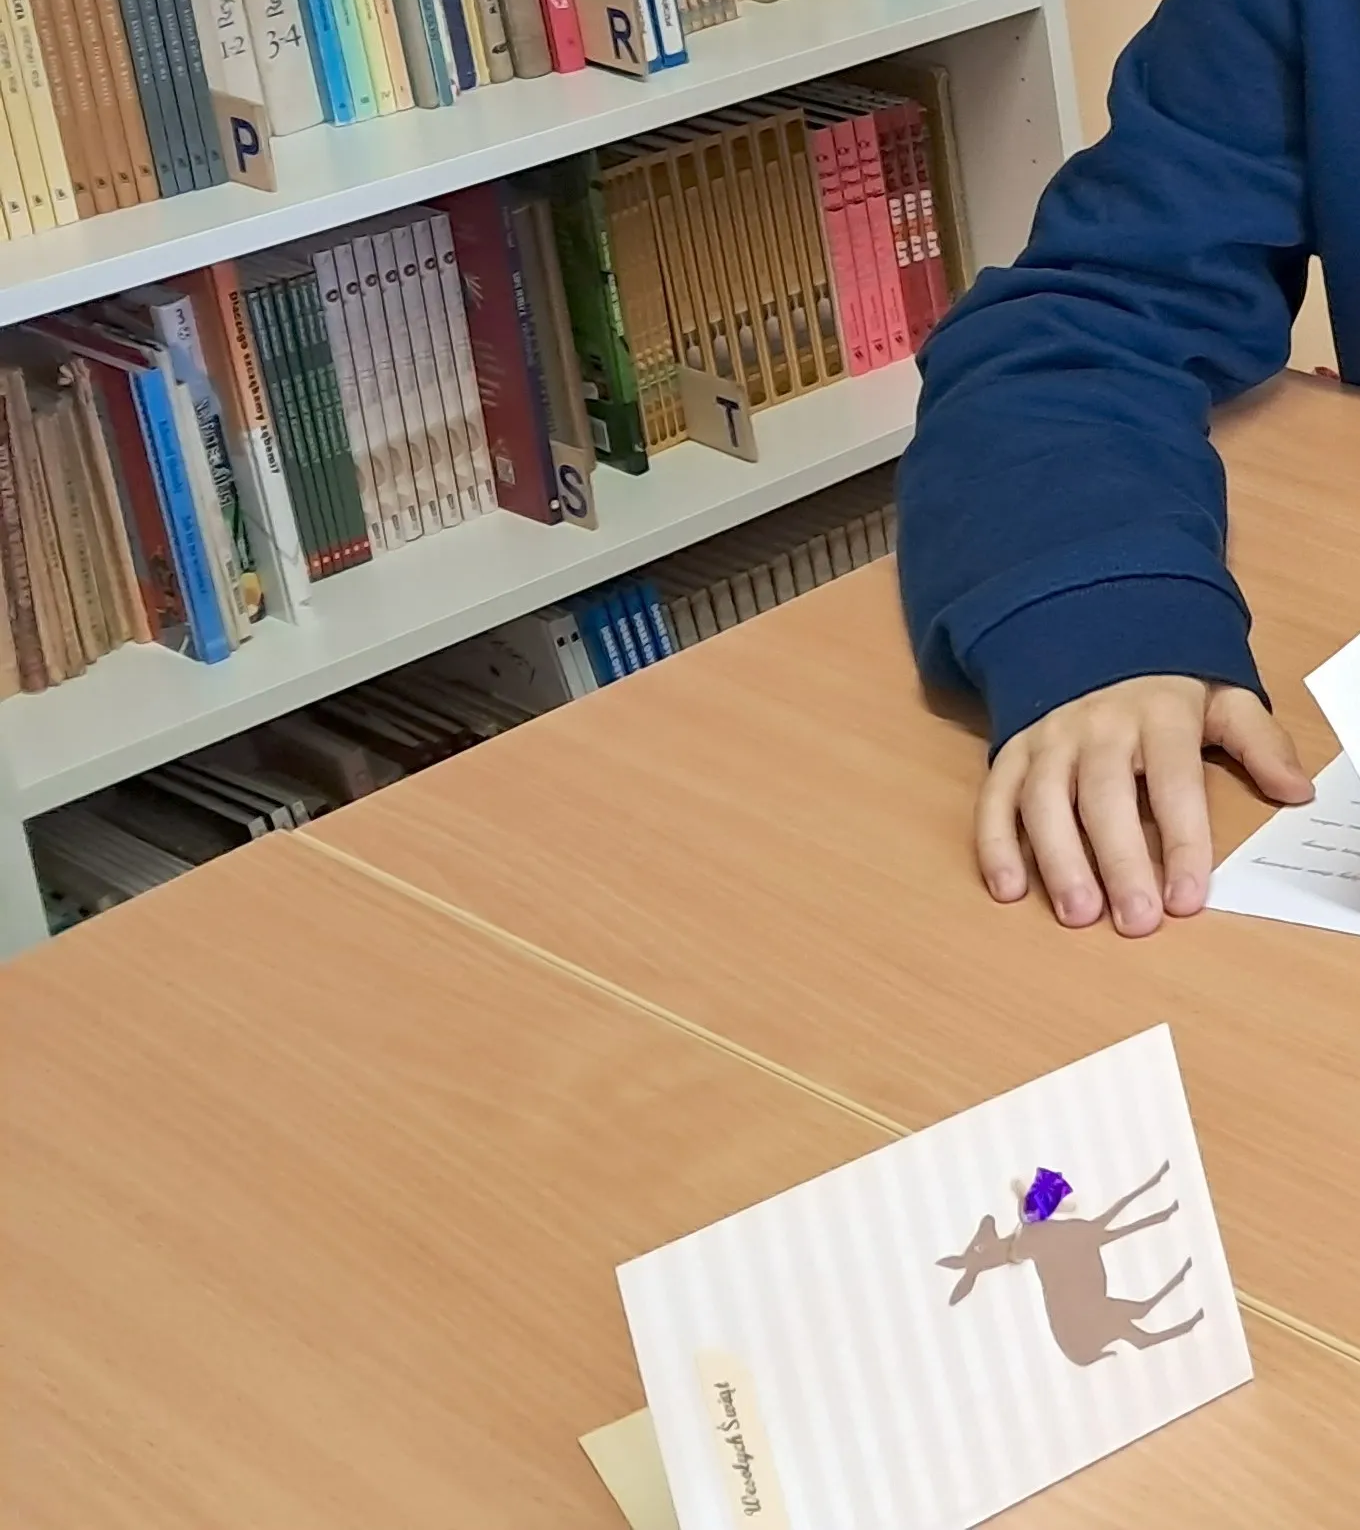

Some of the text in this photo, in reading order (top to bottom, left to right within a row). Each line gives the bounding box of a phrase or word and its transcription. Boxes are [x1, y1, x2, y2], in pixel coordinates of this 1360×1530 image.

[267, 24, 302, 60] 3-4
[607, 7, 639, 64] R
[231, 116, 260, 172] P
[229, 291, 248, 350] Dlaczego
[716, 395, 739, 448] T
[558, 464, 587, 518] S
[714, 1382, 760, 1513] Wesołych Świąt
